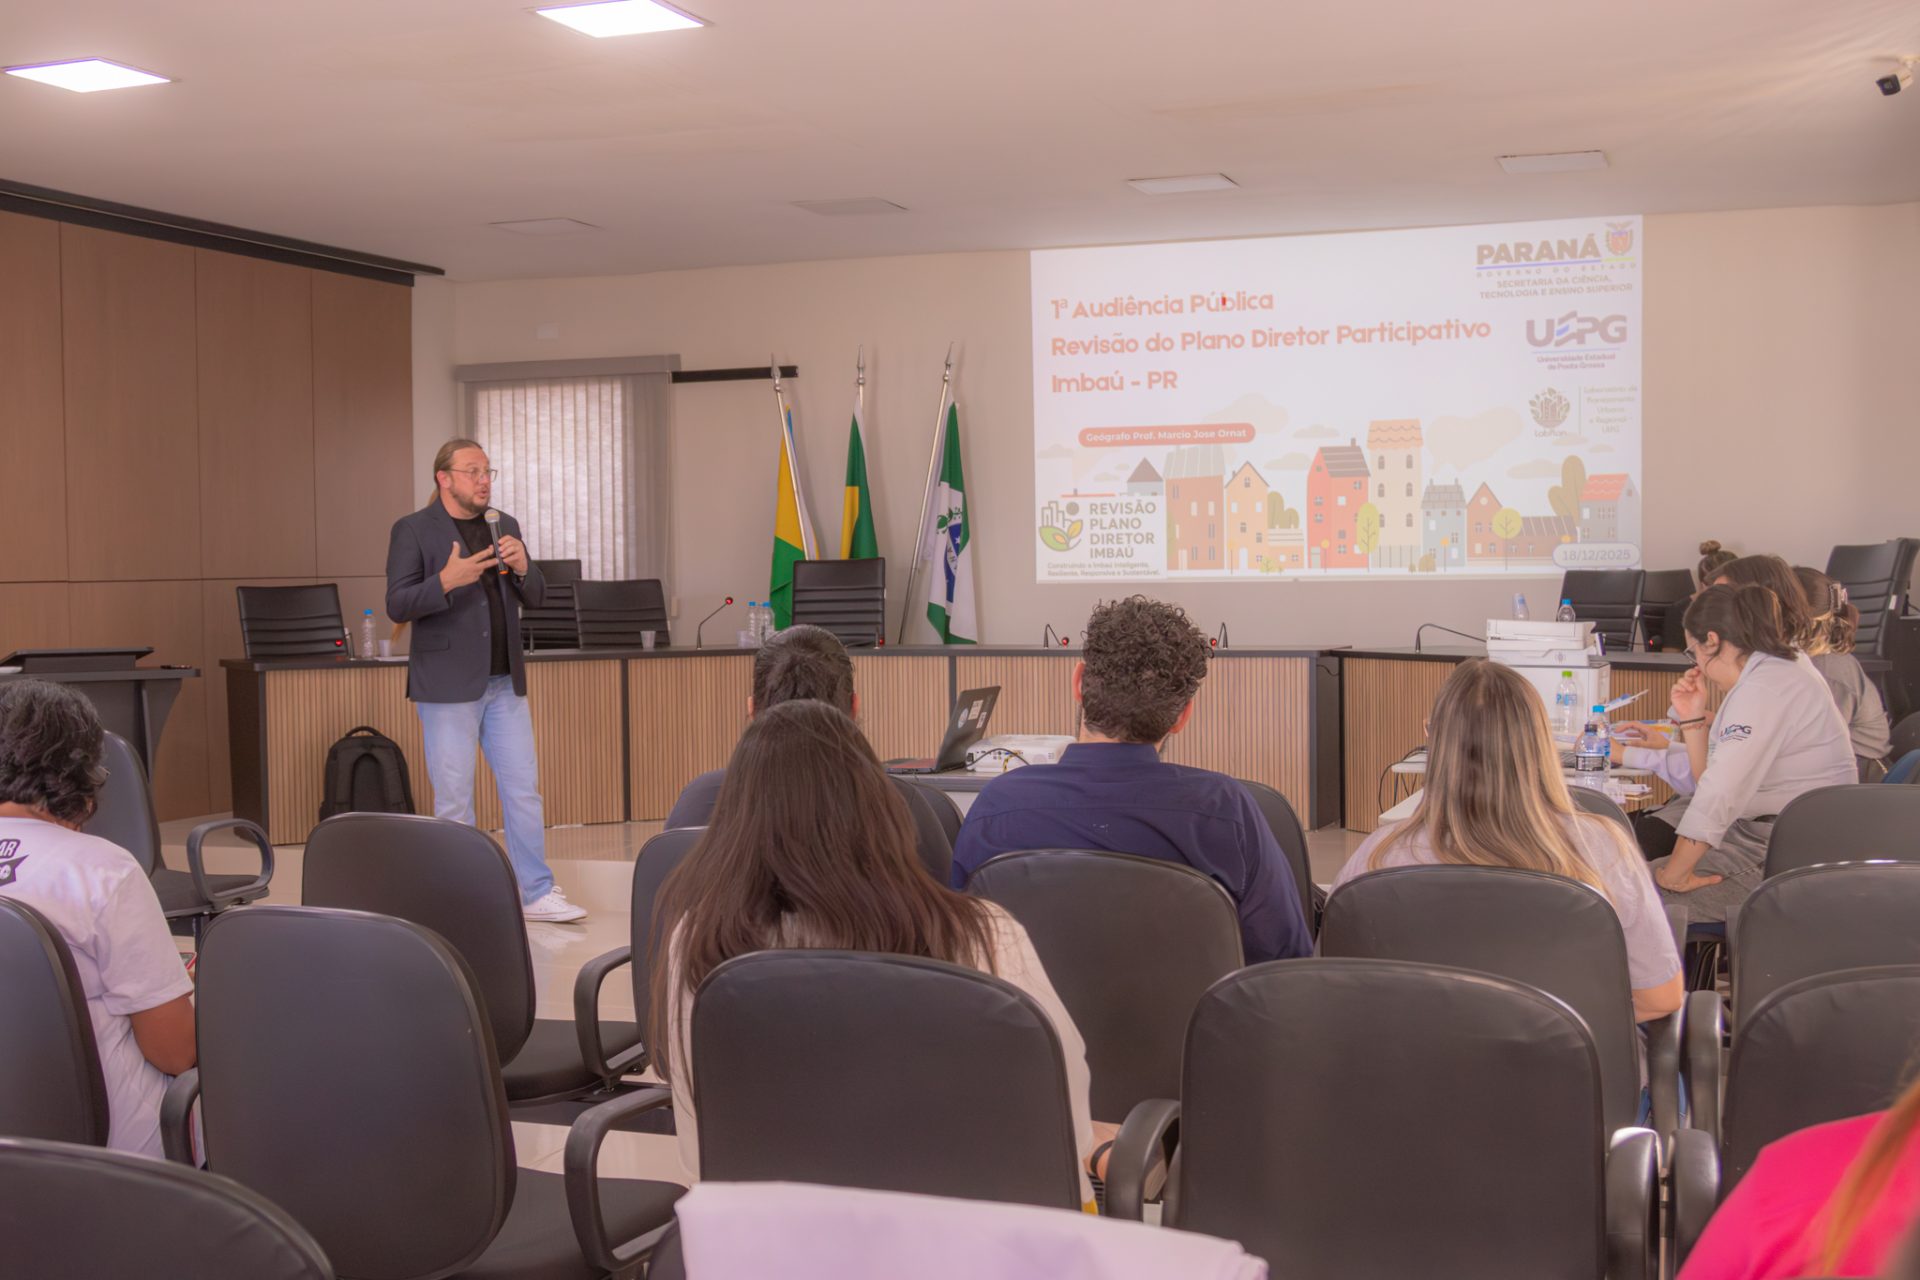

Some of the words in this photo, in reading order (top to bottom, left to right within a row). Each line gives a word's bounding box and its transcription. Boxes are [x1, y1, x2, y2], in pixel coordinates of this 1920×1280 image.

[1476, 233, 1601, 265] PARANÁ
[1496, 277, 1554, 289] SECRETARIA
[1556, 276, 1570, 285] DA
[1480, 288, 1539, 300] TECNOLOGIA
[1541, 288, 1547, 297] E
[1549, 285, 1584, 296] ENSINO
[1586, 282, 1633, 294] SUPERIOR
[1072, 295, 1184, 319] Audiência
[1190, 291, 1274, 313] Pública
[1051, 332, 1139, 356] Revisão
[1145, 332, 1175, 352] do
[1181, 331, 1245, 351] Plano
[1252, 326, 1330, 347] Diretor
[1336, 318, 1492, 346] Participativo
[1526, 310, 1628, 348] UEPG
[1052, 370, 1124, 393] Imbaú
[1147, 371, 1178, 389] PR
[1086, 432, 1131, 443] Geógrafo
[1133, 431, 1156, 441] Prof.
[1218, 428, 1247, 438] Ornat
[1089, 499, 1157, 515] REVISÃO
[1089, 517, 1142, 530] PLANO
[1090, 532, 1155, 545] DIRETOR
[1090, 546, 1135, 559] IMBAÚ
[1562, 549, 1632, 561] 18/12/2025
